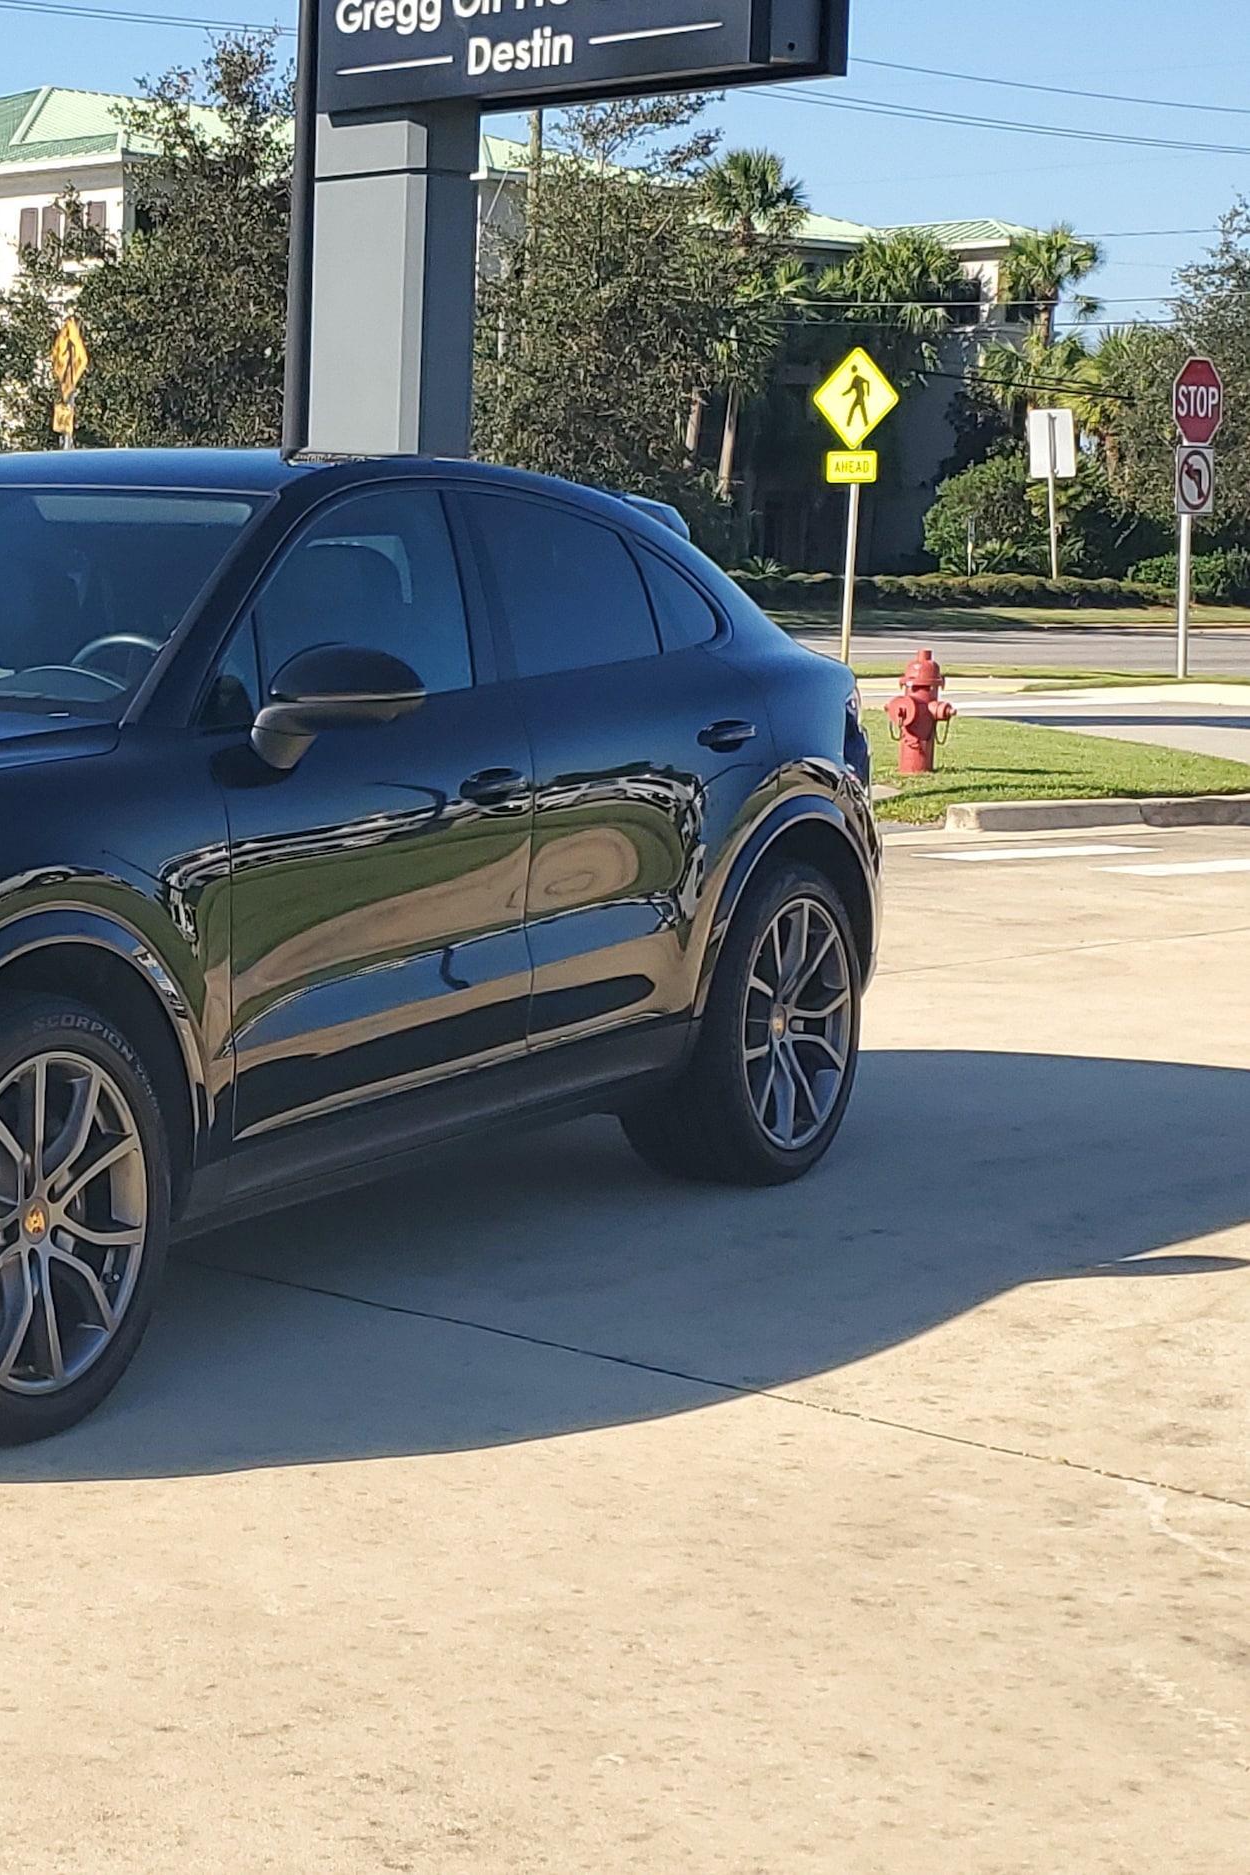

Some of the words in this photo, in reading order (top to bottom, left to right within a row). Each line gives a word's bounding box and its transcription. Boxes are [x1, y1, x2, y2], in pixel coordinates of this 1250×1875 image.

[335, 0, 443, 35] Gregg
[467, 26, 574, 76] Destin
[1177, 384, 1219, 419] STOP
[834, 460, 870, 474] AHEAD
[33, 1013, 135, 1063] SCORPION
